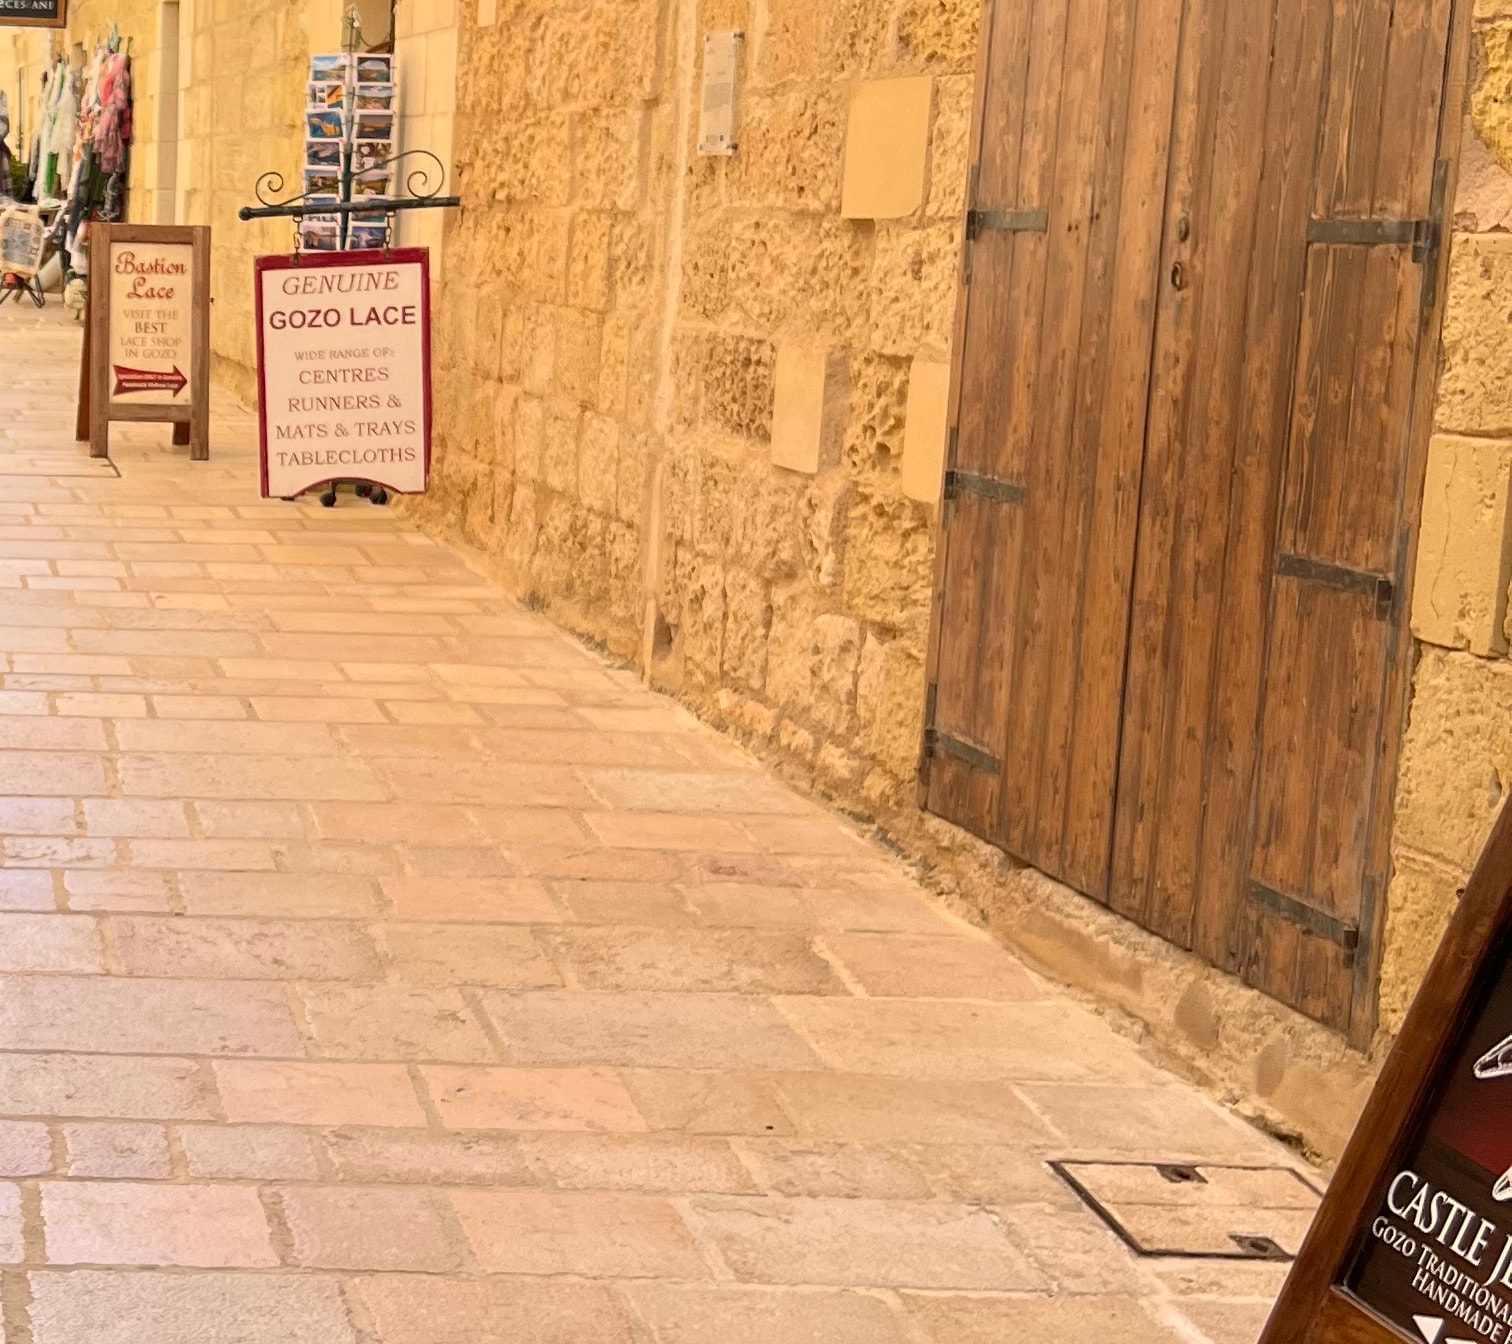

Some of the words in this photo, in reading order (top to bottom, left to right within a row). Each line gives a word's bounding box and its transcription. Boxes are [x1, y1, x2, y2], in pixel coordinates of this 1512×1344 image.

[115, 250, 187, 274] Bastion
[127, 276, 174, 299] Lace
[282, 271, 400, 295] GENUINE
[122, 309, 152, 318] VISIT
[156, 310, 179, 320] THE
[269, 308, 341, 330] GOZO
[350, 306, 416, 326] LACE
[134, 321, 167, 334] BEST
[120, 336, 146, 346] LACE
[151, 337, 182, 347] SHOP
[125, 348, 137, 358] IN
[142, 349, 177, 359] GOZO
[293, 350, 326, 361] WIDE
[329, 348, 370, 360] RANGE
[299, 366, 390, 384] CENTRES
[288, 394, 381, 412] RUNNERS
[386, 394, 402, 409] &
[276, 424, 328, 440] MATS
[334, 423, 349, 437] &
[354, 420, 416, 438] TRAYS
[277, 447, 416, 467] TABLECLOTHS
[1387, 1169, 1496, 1267] CASTLE
[1411, 1267, 1503, 1344] HANDMADE
